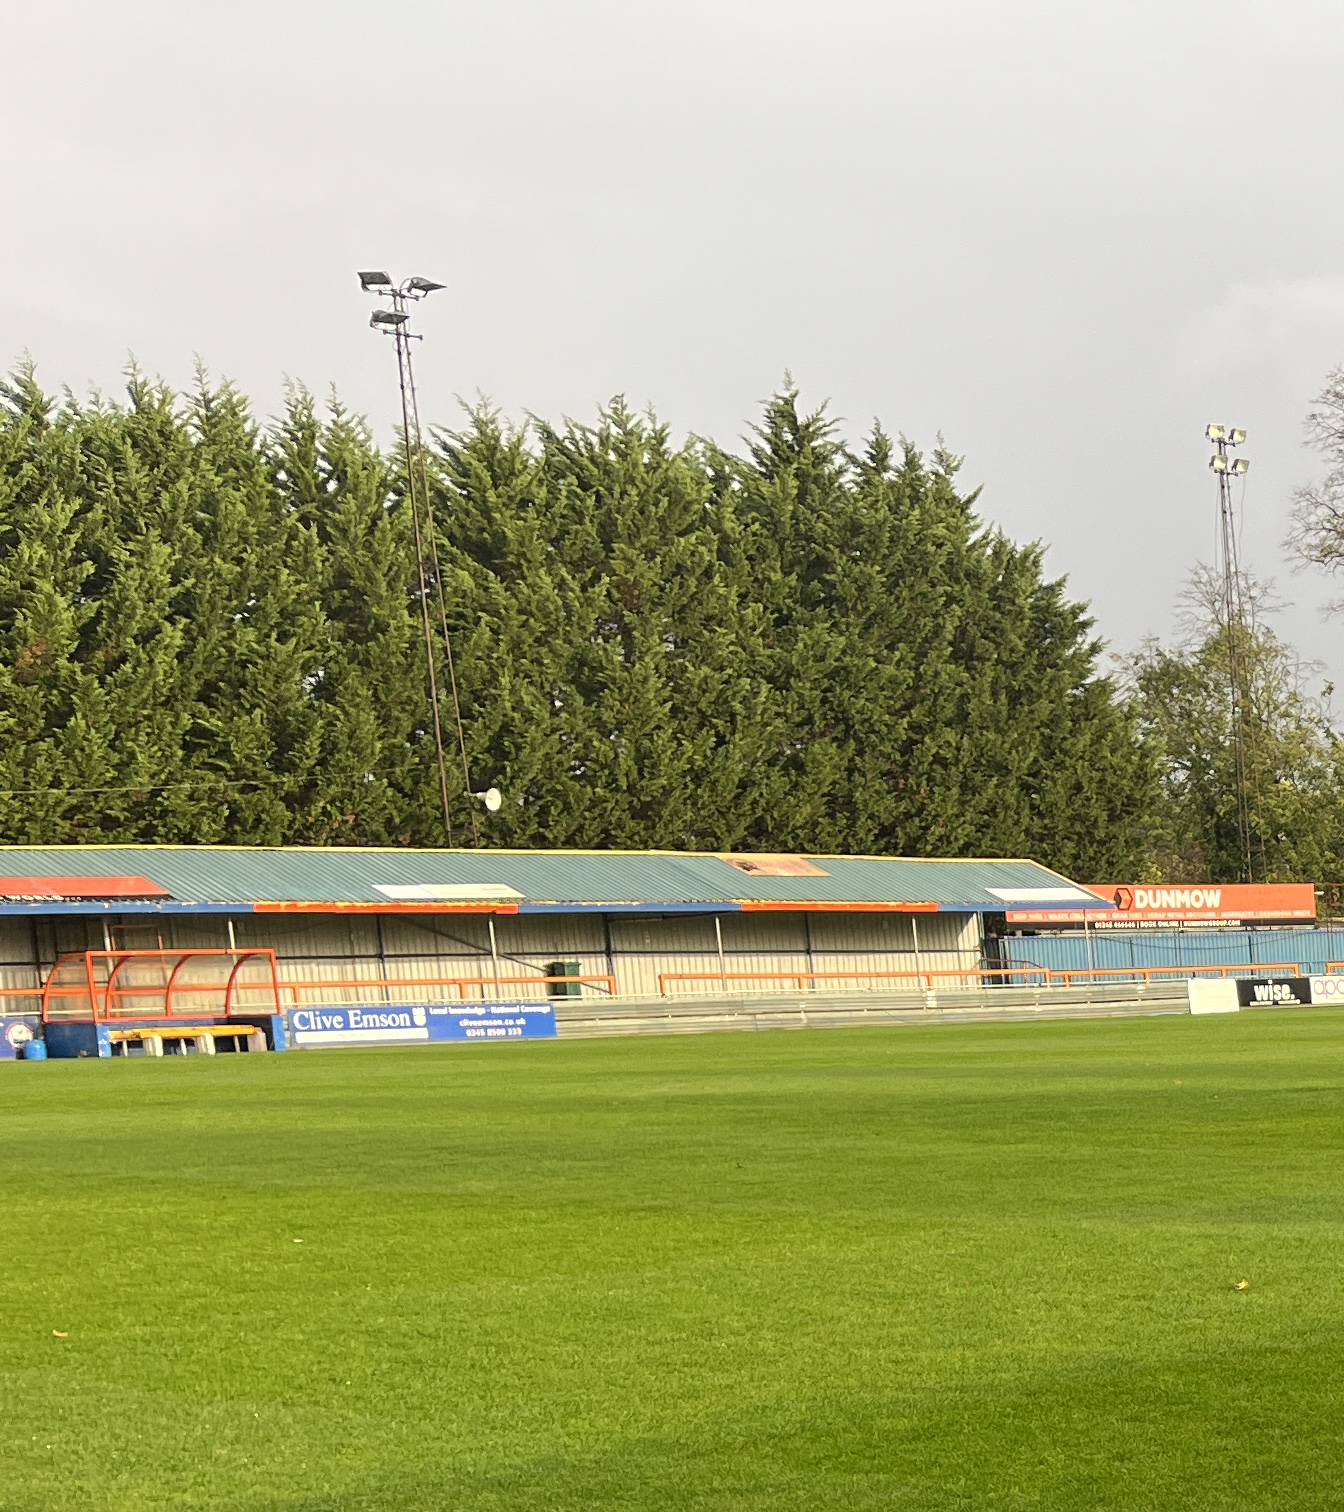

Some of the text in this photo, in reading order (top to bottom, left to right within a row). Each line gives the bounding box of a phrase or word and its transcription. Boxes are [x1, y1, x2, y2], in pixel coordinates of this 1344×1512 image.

[1135, 889, 1221, 909] DUNMOW
[1253, 979, 1295, 1001] wise.
[293, 1009, 411, 1030] Clive Emson
